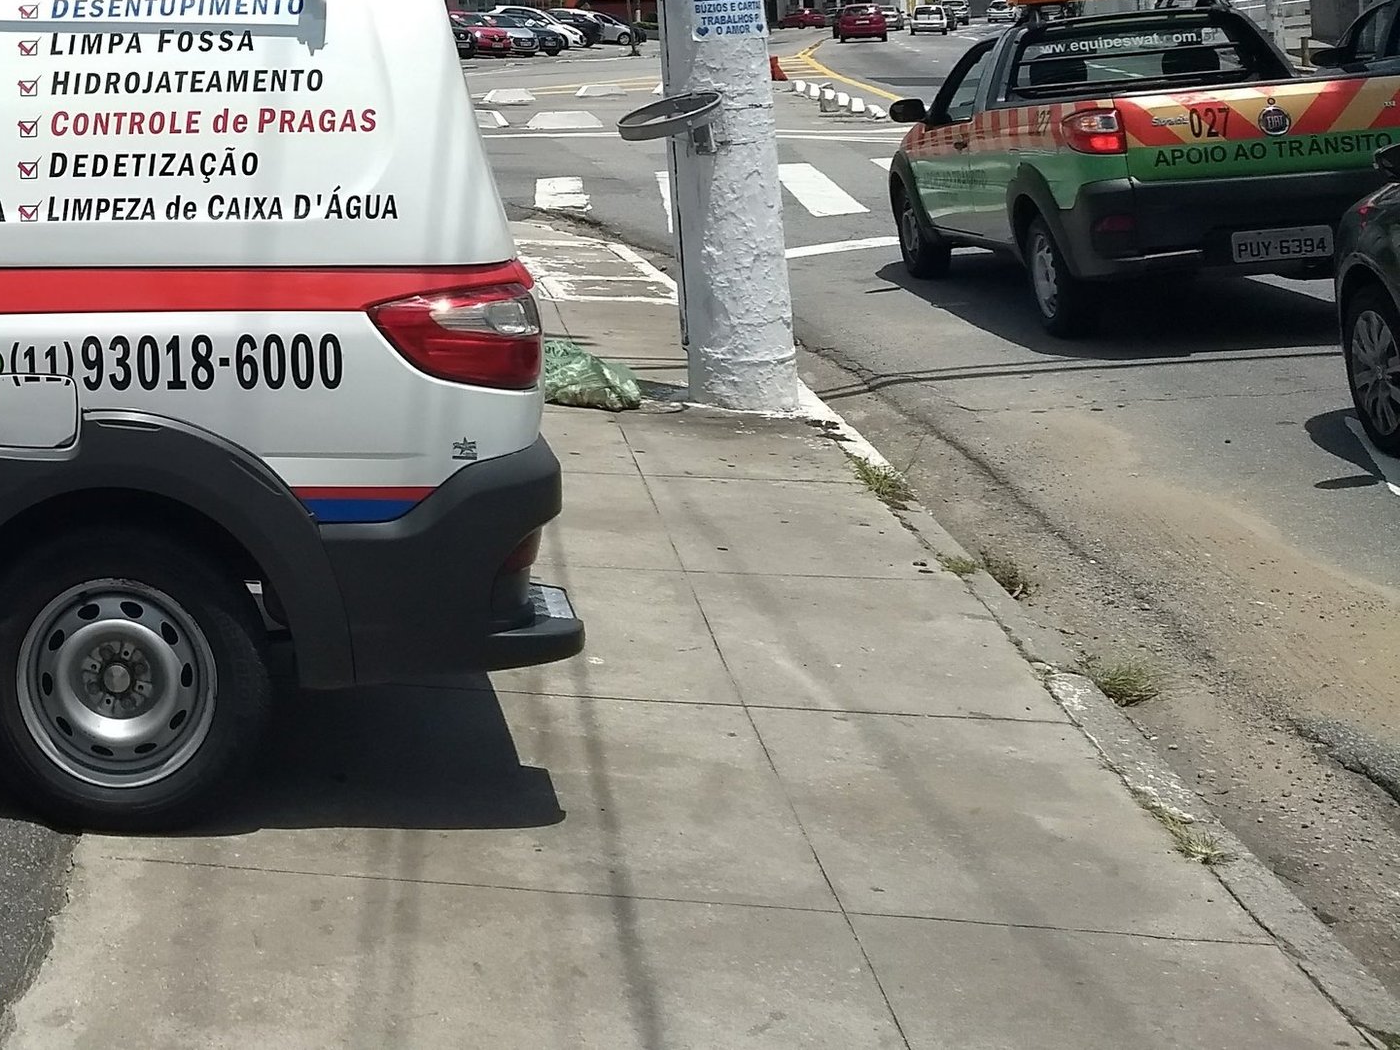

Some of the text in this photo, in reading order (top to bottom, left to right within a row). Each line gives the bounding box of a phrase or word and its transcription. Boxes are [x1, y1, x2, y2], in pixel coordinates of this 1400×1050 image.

[49, 29, 255, 56] LIMPA FOSSA
[50, 68, 324, 95] HIDROJATEAMENTO
[50, 107, 378, 137] CONTROLE de PRAGAS
[1188, 106, 1231, 139] 027
[48, 147, 260, 184] DEDETIZAÇÃO
[1154, 132, 1394, 168] APOIO AO TRÂNSITO
[46, 185, 399, 222] LIMPEZA de CAIXA D'ÁGUA
